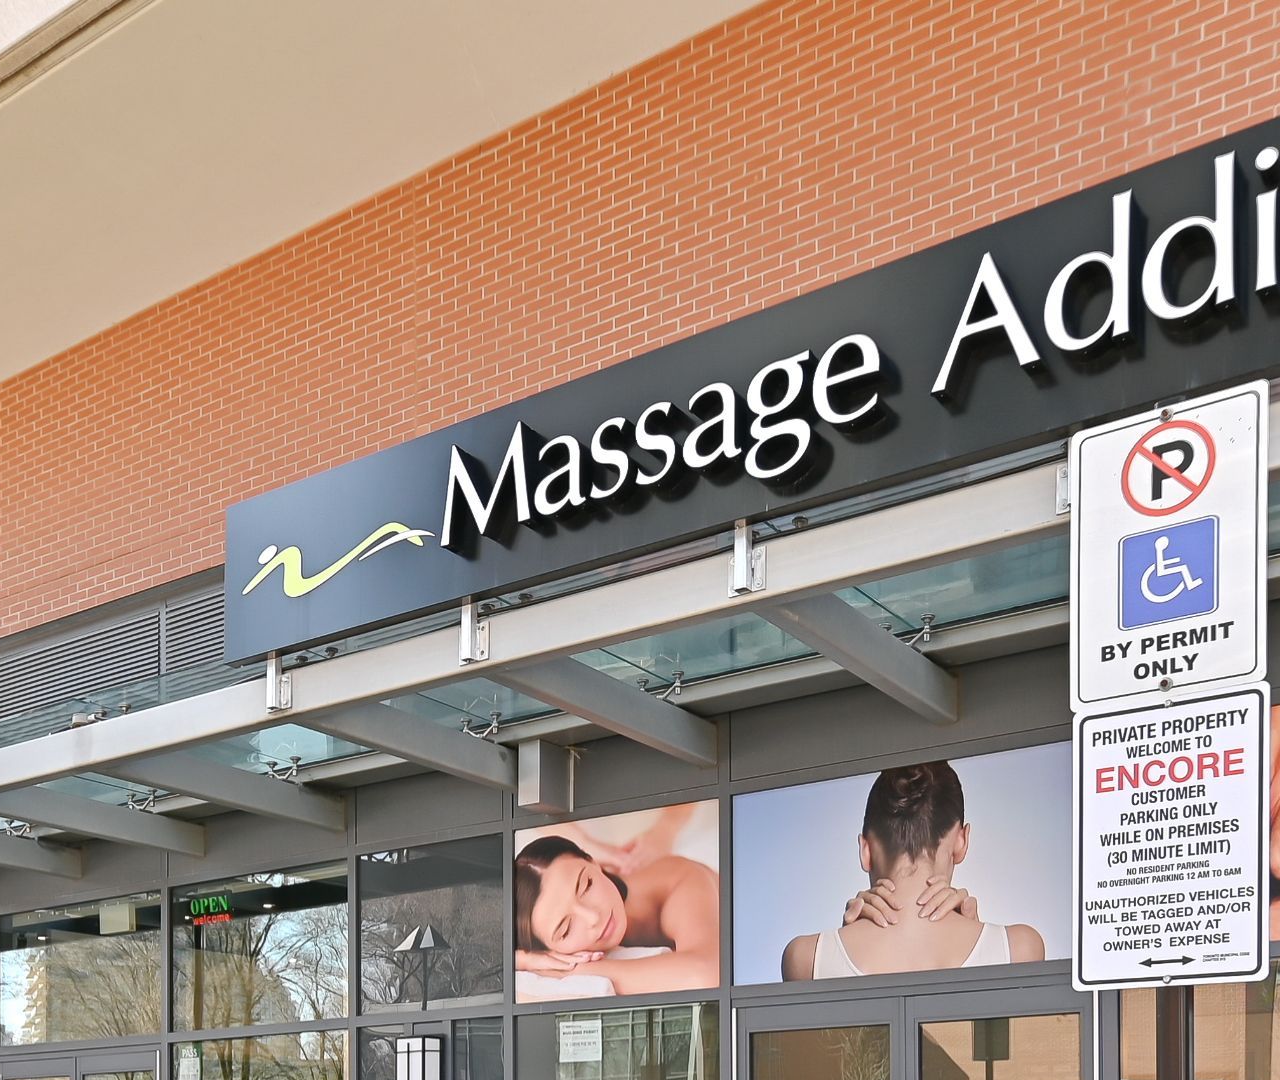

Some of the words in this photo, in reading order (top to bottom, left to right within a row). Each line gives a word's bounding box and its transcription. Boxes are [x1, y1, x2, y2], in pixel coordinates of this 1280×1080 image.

[440, 333, 881, 549] Massage
[1101, 641, 1133, 662] BY
[1140, 621, 1234, 655] PERMIT
[1133, 652, 1199, 680] ONLY
[1092, 722, 1157, 747] PRIVATE
[1161, 708, 1249, 737] PROPERTY
[1126, 738, 1191, 759] WELCOME
[1195, 734, 1212, 749] TO
[1095, 748, 1245, 794] ENCORE
[1131, 784, 1206, 806] CUSTOMER
[1120, 806, 1178, 826] PARKING
[1182, 802, 1218, 818] ONLY
[1100, 830, 1141, 847] WHILE
[1146, 828, 1164, 842] ON
[1168, 818, 1240, 840] PREMISES
[1107, 850, 1128, 867] (30
[1131, 844, 1184, 862] MINUTE
[1187, 839, 1231, 856] LIMIT)
[1097, 880, 1108, 889] NO
[1109, 876, 1150, 888] OVERNIGHT
[1151, 873, 1184, 884] PARKING
[1186, 871, 1196, 880] 12
[1197, 870, 1211, 879] AM
[1212, 869, 1222, 878] TO
[1223, 867, 1242, 877] 6AM
[1126, 867, 1137, 876] NO
[1139, 864, 1175, 874] RESIDENT
[1176, 860, 1210, 870] PARKING
[191, 895, 228, 915] OPEN
[1085, 892, 1186, 911] UNAUTHORIZED
[1188, 886, 1255, 902] VEHICLES
[193, 913, 231, 925] welcome
[1088, 913, 1118, 925] WILL
[1121, 911, 1138, 922] BE
[1141, 906, 1194, 921] TAGGED
[1196, 901, 1251, 916] AND/OR
[1114, 923, 1161, 937] TOWED
[1164, 920, 1202, 934] AWAY
[1204, 919, 1222, 930] AT
[1103, 938, 1162, 952] OWNER'S
[1169, 932, 1231, 947] EXPENSE
[181, 1048, 198, 1058] PASS
